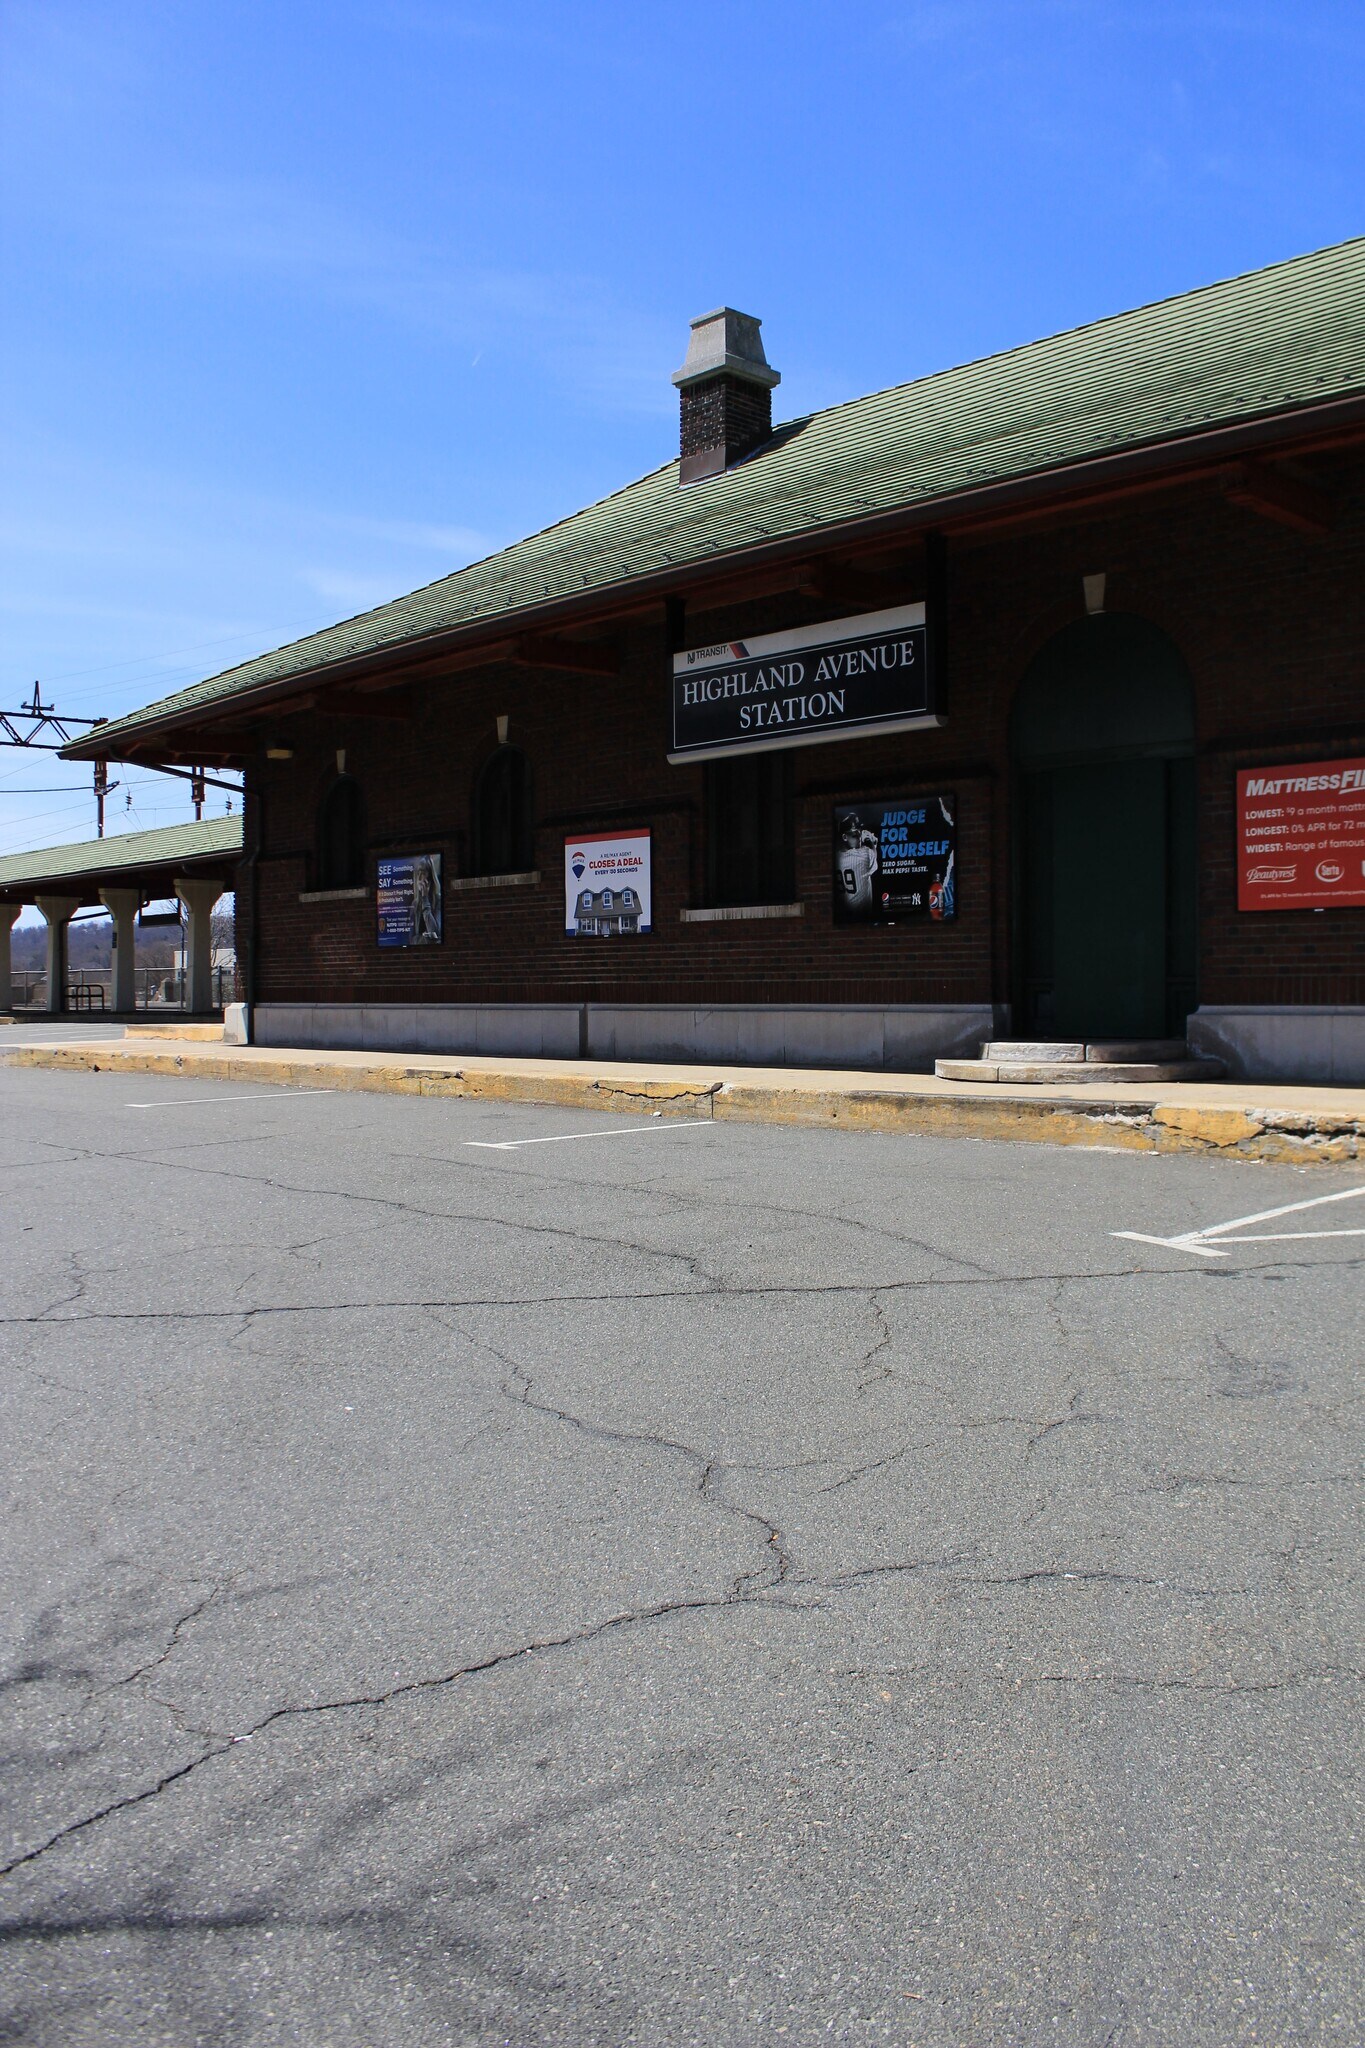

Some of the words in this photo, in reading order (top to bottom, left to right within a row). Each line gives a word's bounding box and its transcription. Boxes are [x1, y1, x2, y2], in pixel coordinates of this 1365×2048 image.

[696, 645, 728, 660] TRANSIT
[683, 662, 805, 705] HIGHLAND
[814, 640, 915, 682] AVENUE
[739, 689, 845, 729] STATION
[881, 809, 927, 827] JUDGE
[1245, 808, 1285, 820] LOWEST:
[1306, 804, 1337, 815] month
[881, 827, 909, 843] FOR
[1245, 825, 1289, 837] LONGEST:
[1291, 824, 1305, 834] 0%
[1307, 822, 1327, 832] APR
[1328, 821, 1342, 831] for
[1343, 820, 1355, 829] 72
[881, 840, 950, 859] YOURSELF
[1245, 843, 1284, 854] WIDEST:
[1285, 842, 1315, 852] Range
[1317, 839, 1328, 848] of
[1329, 838, 1365, 848] famous
[378, 865, 392, 876] SEE
[589, 859, 616, 869] CLOSES
[623, 857, 643, 866] DEAL
[595, 868, 609, 876] EVERY
[1246, 867, 1297, 882] Beautyrest
[378, 878, 392, 888] SAY
